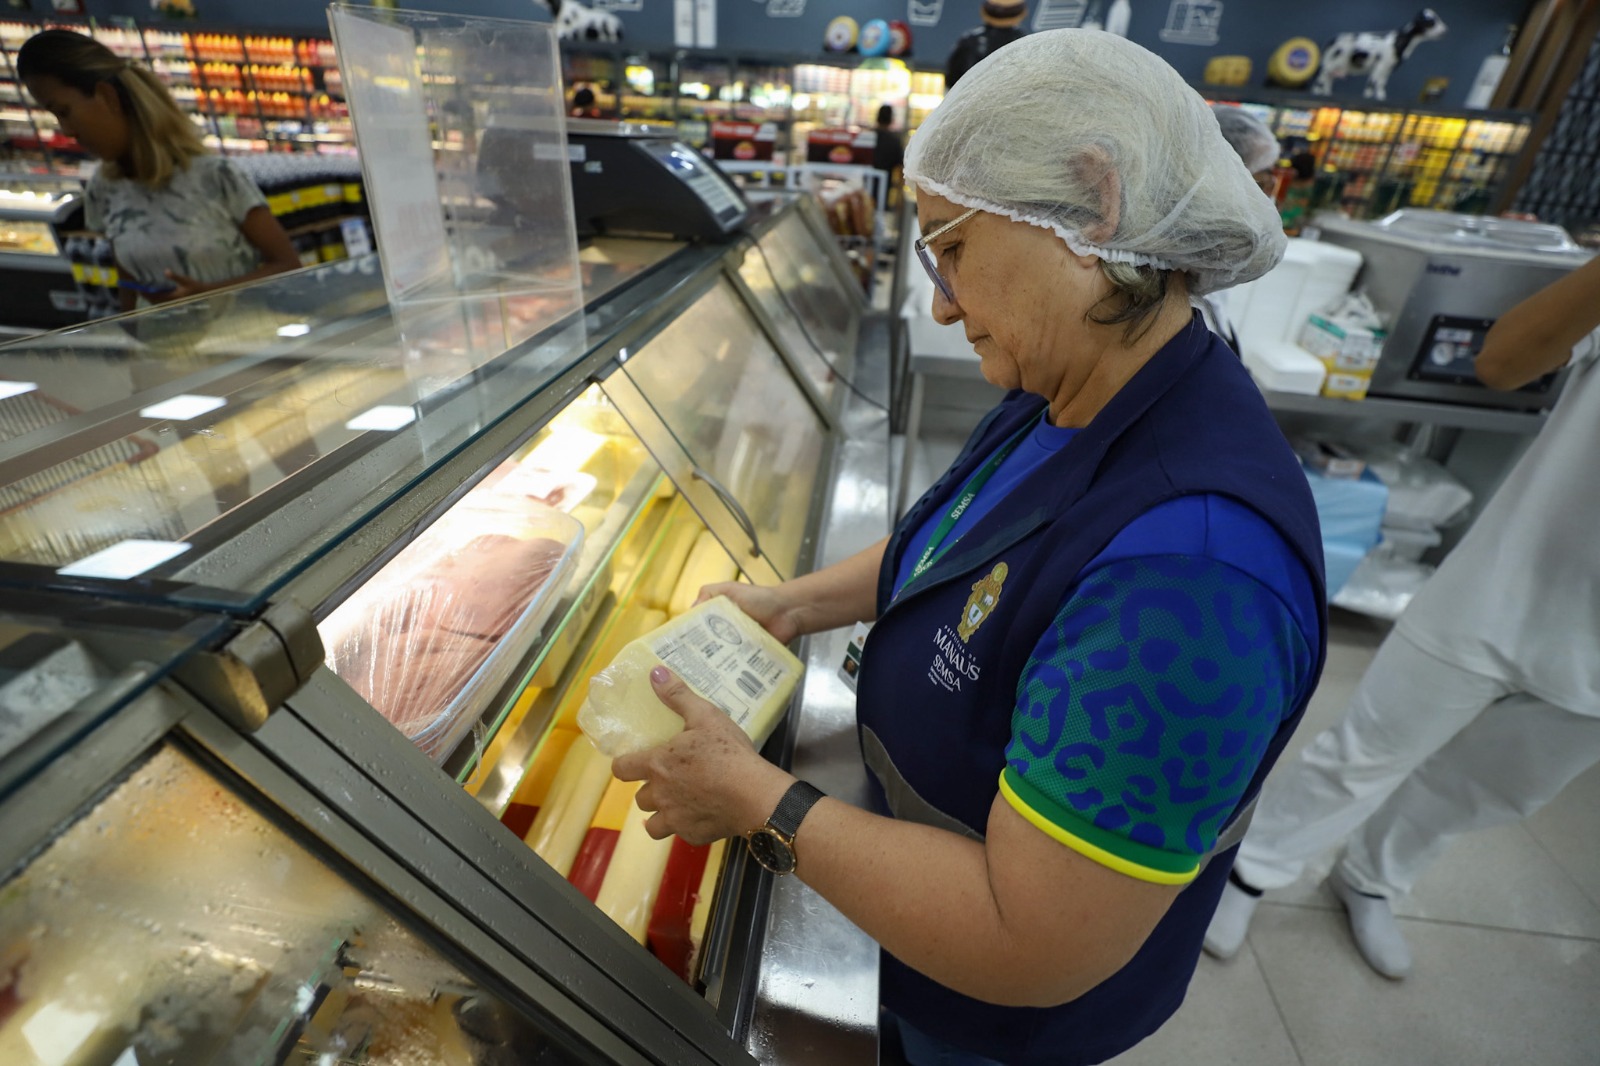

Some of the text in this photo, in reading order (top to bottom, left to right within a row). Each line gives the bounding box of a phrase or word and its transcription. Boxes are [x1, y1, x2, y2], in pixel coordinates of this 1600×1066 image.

[951, 492, 975, 520] SEMSA
[933, 627, 981, 681] MANAUS
[933, 654, 961, 692] SEMSA
